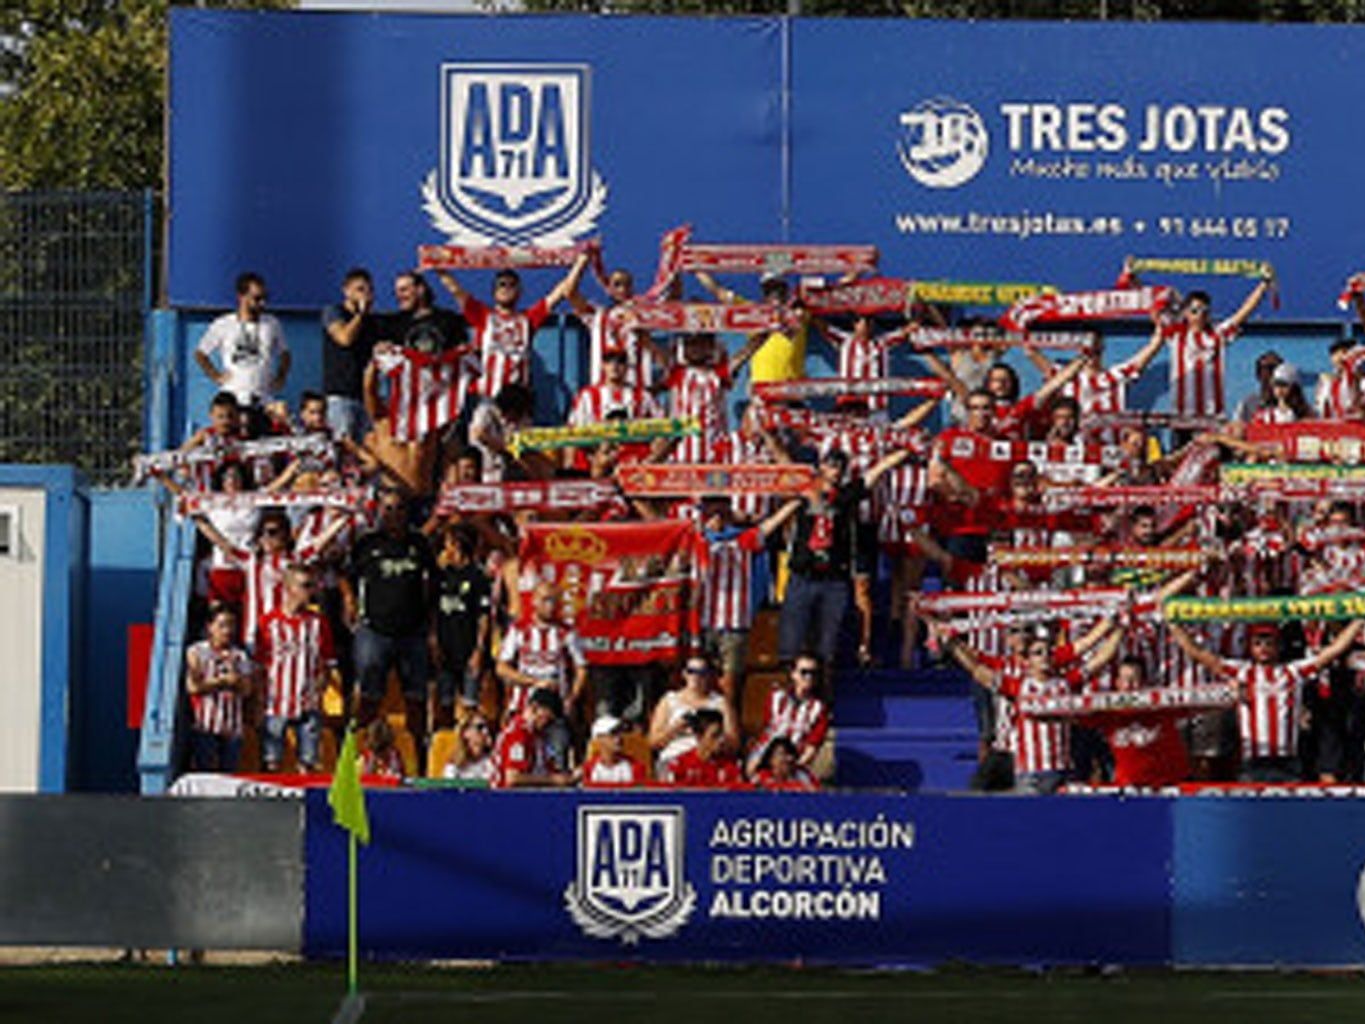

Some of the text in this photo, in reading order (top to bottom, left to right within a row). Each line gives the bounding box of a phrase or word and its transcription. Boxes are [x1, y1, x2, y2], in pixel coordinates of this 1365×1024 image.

[460, 83, 570, 178] ADA
[1001, 104, 1290, 154] TRES JOTAS
[500, 150, 527, 178] 71
[1155, 163, 1198, 188] que
[896, 212, 1123, 239] www.tresjotas.es
[709, 814, 914, 849] AGRUPACIÓN
[590, 820, 671, 888] ADA
[712, 858, 886, 884] DEPORTIVA
[709, 882, 880, 918] ALCORCÓN
